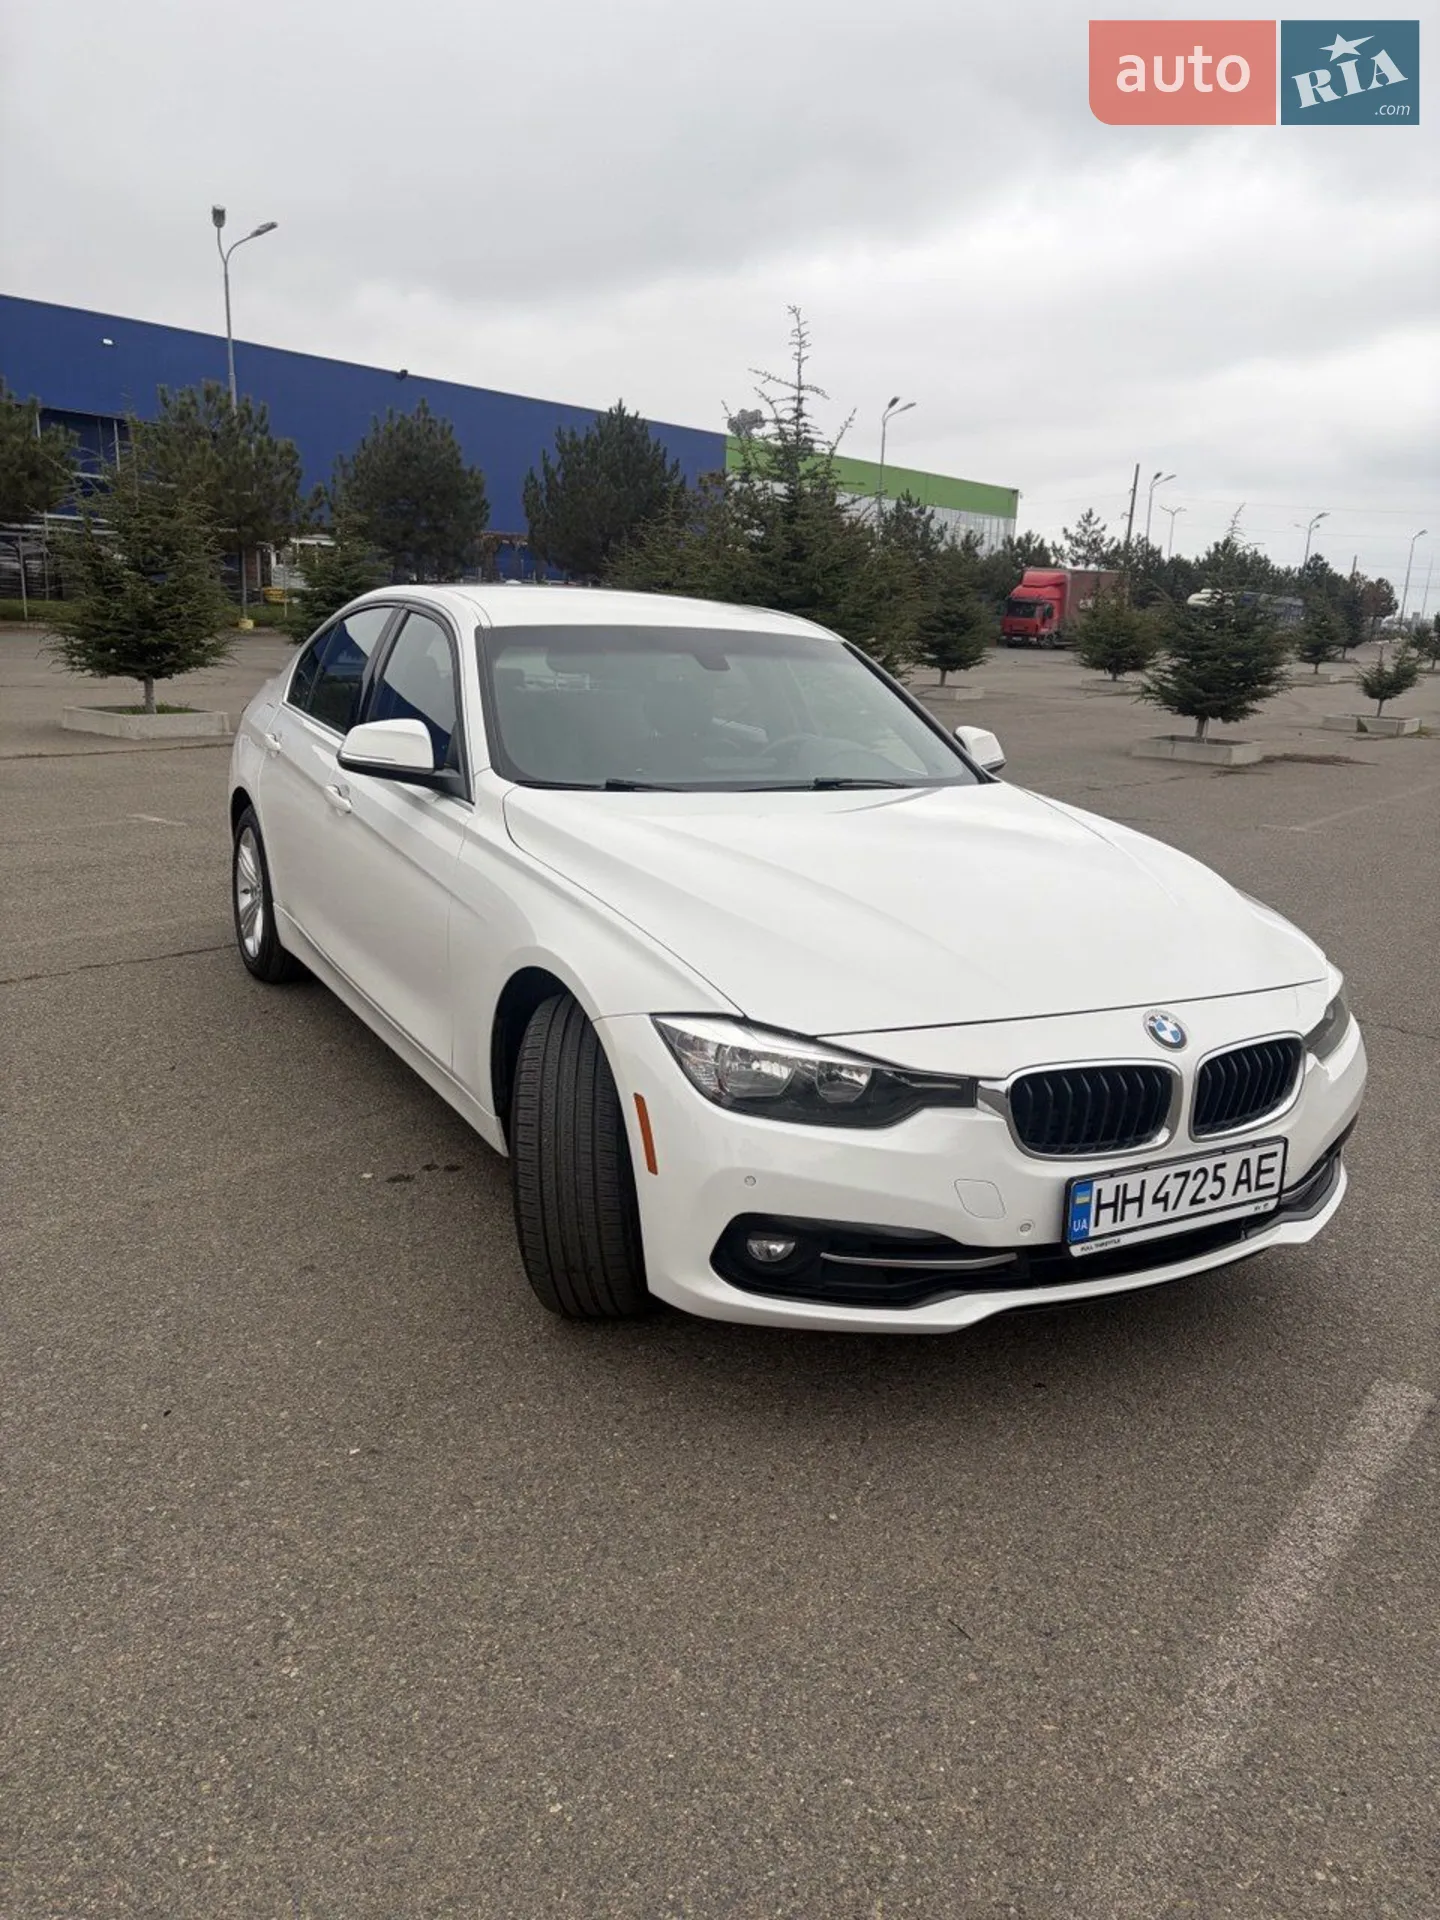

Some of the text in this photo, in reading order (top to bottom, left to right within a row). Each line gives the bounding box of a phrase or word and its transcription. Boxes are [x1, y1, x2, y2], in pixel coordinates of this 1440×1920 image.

[1094, 1151, 1279, 1228] HH 4725 AE
[1073, 1218, 1089, 1232] UA
